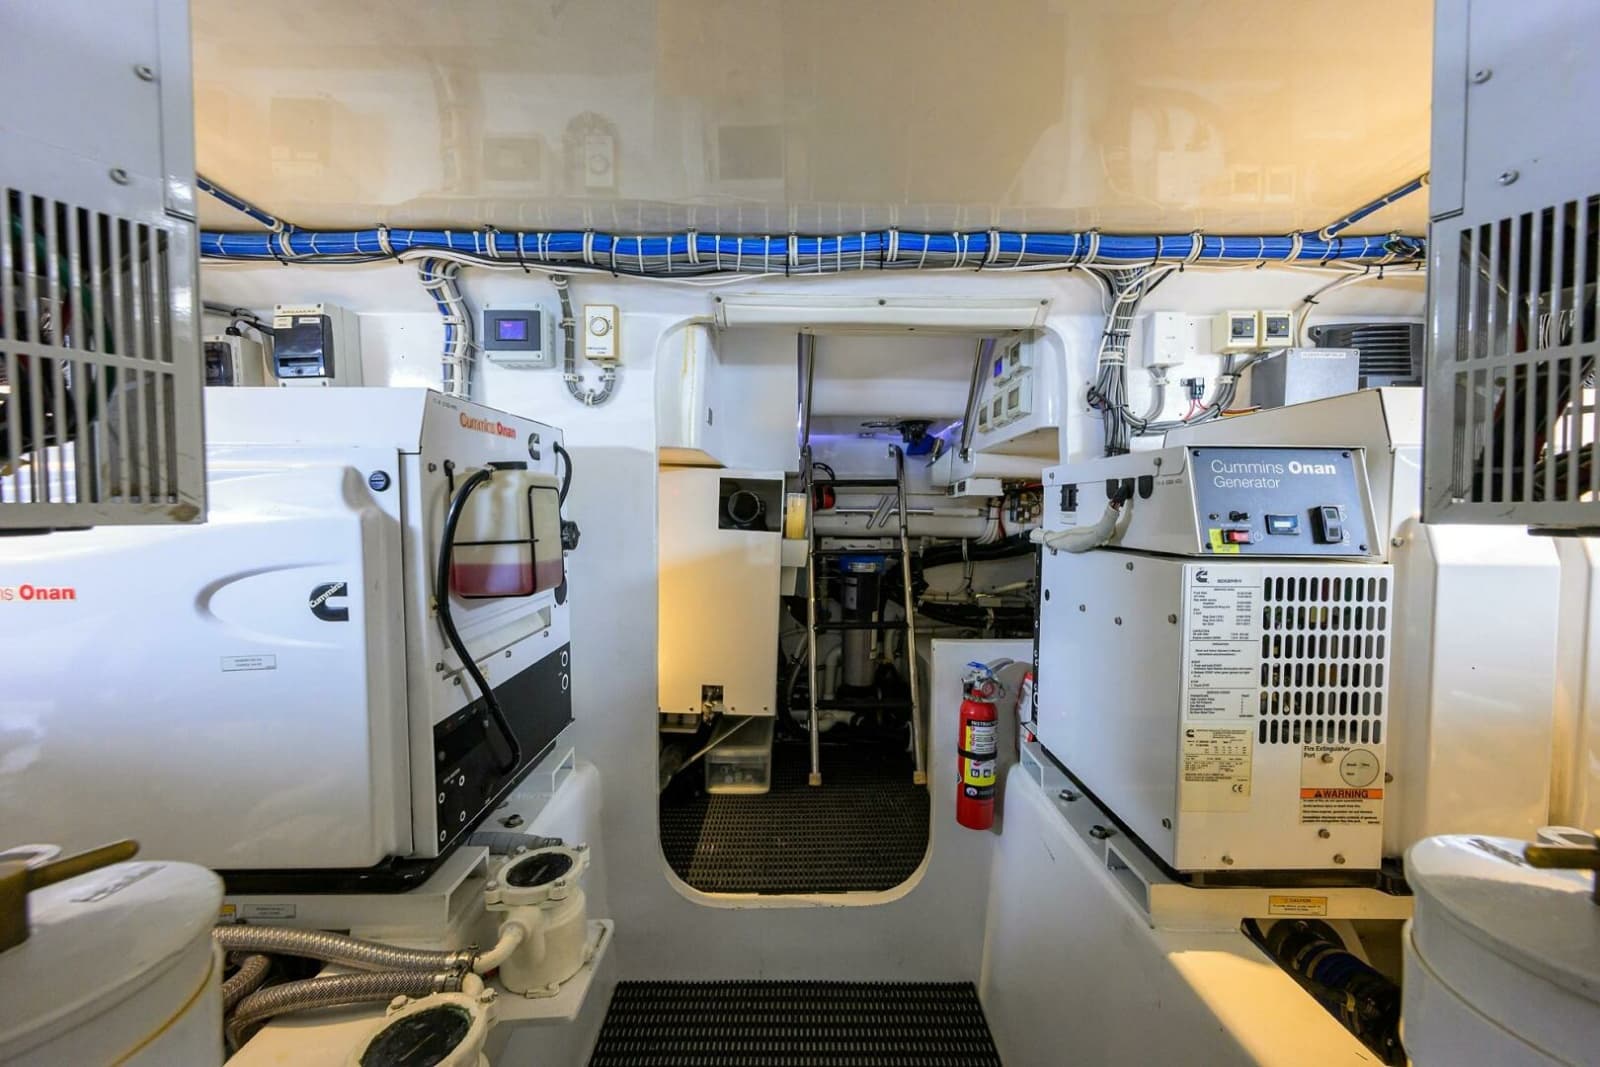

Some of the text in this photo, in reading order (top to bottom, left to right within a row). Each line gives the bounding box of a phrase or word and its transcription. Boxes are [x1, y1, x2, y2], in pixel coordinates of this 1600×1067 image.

[460, 412, 517, 439] Cummins Onan
[1211, 459, 1337, 475] Cummins Onan
[1213, 475, 1281, 489] Generator
[19, 584, 76, 601] Onan
[309, 582, 345, 608] Cummins
[1323, 789, 1369, 799] WARNING
